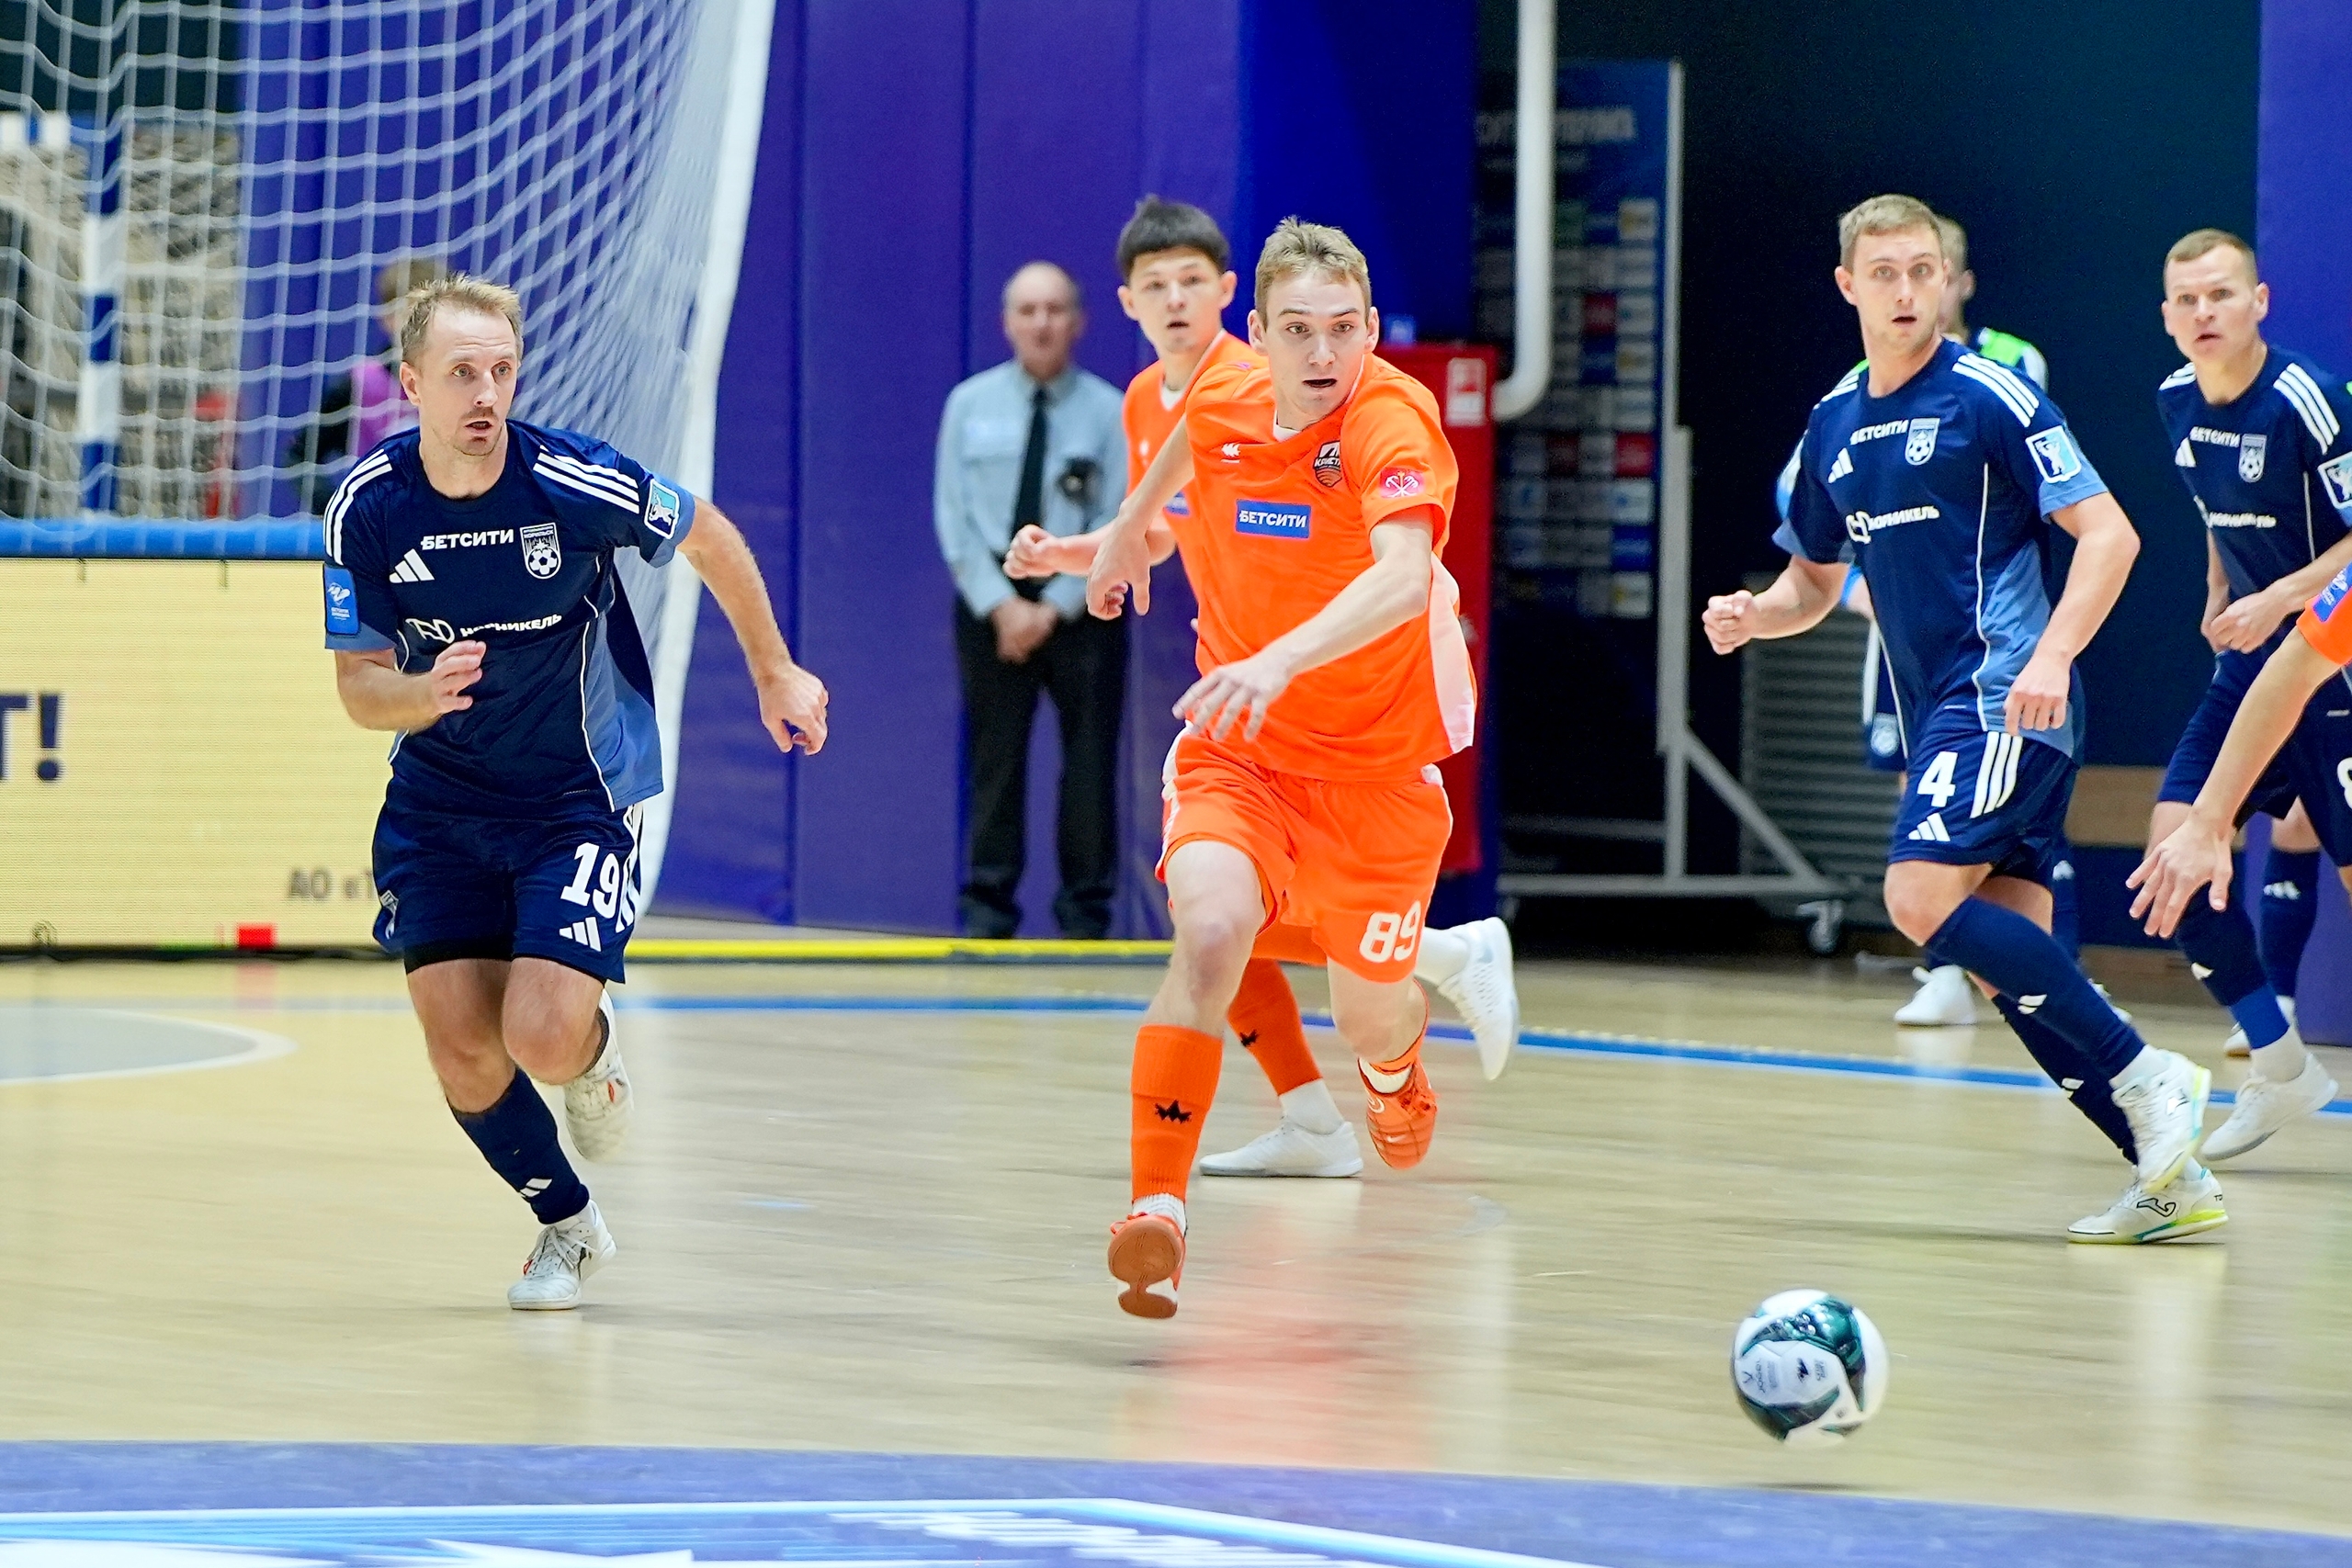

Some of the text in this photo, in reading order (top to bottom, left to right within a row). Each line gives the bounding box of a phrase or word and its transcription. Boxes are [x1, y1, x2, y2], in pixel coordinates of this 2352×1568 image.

[420, 528, 514, 551] БЕТСИТИ
[1238, 510, 1306, 528] БЕТСИТИ
[1917, 750, 1958, 807] 4
[560, 841, 620, 919] 19
[1359, 900, 1421, 964] 89
